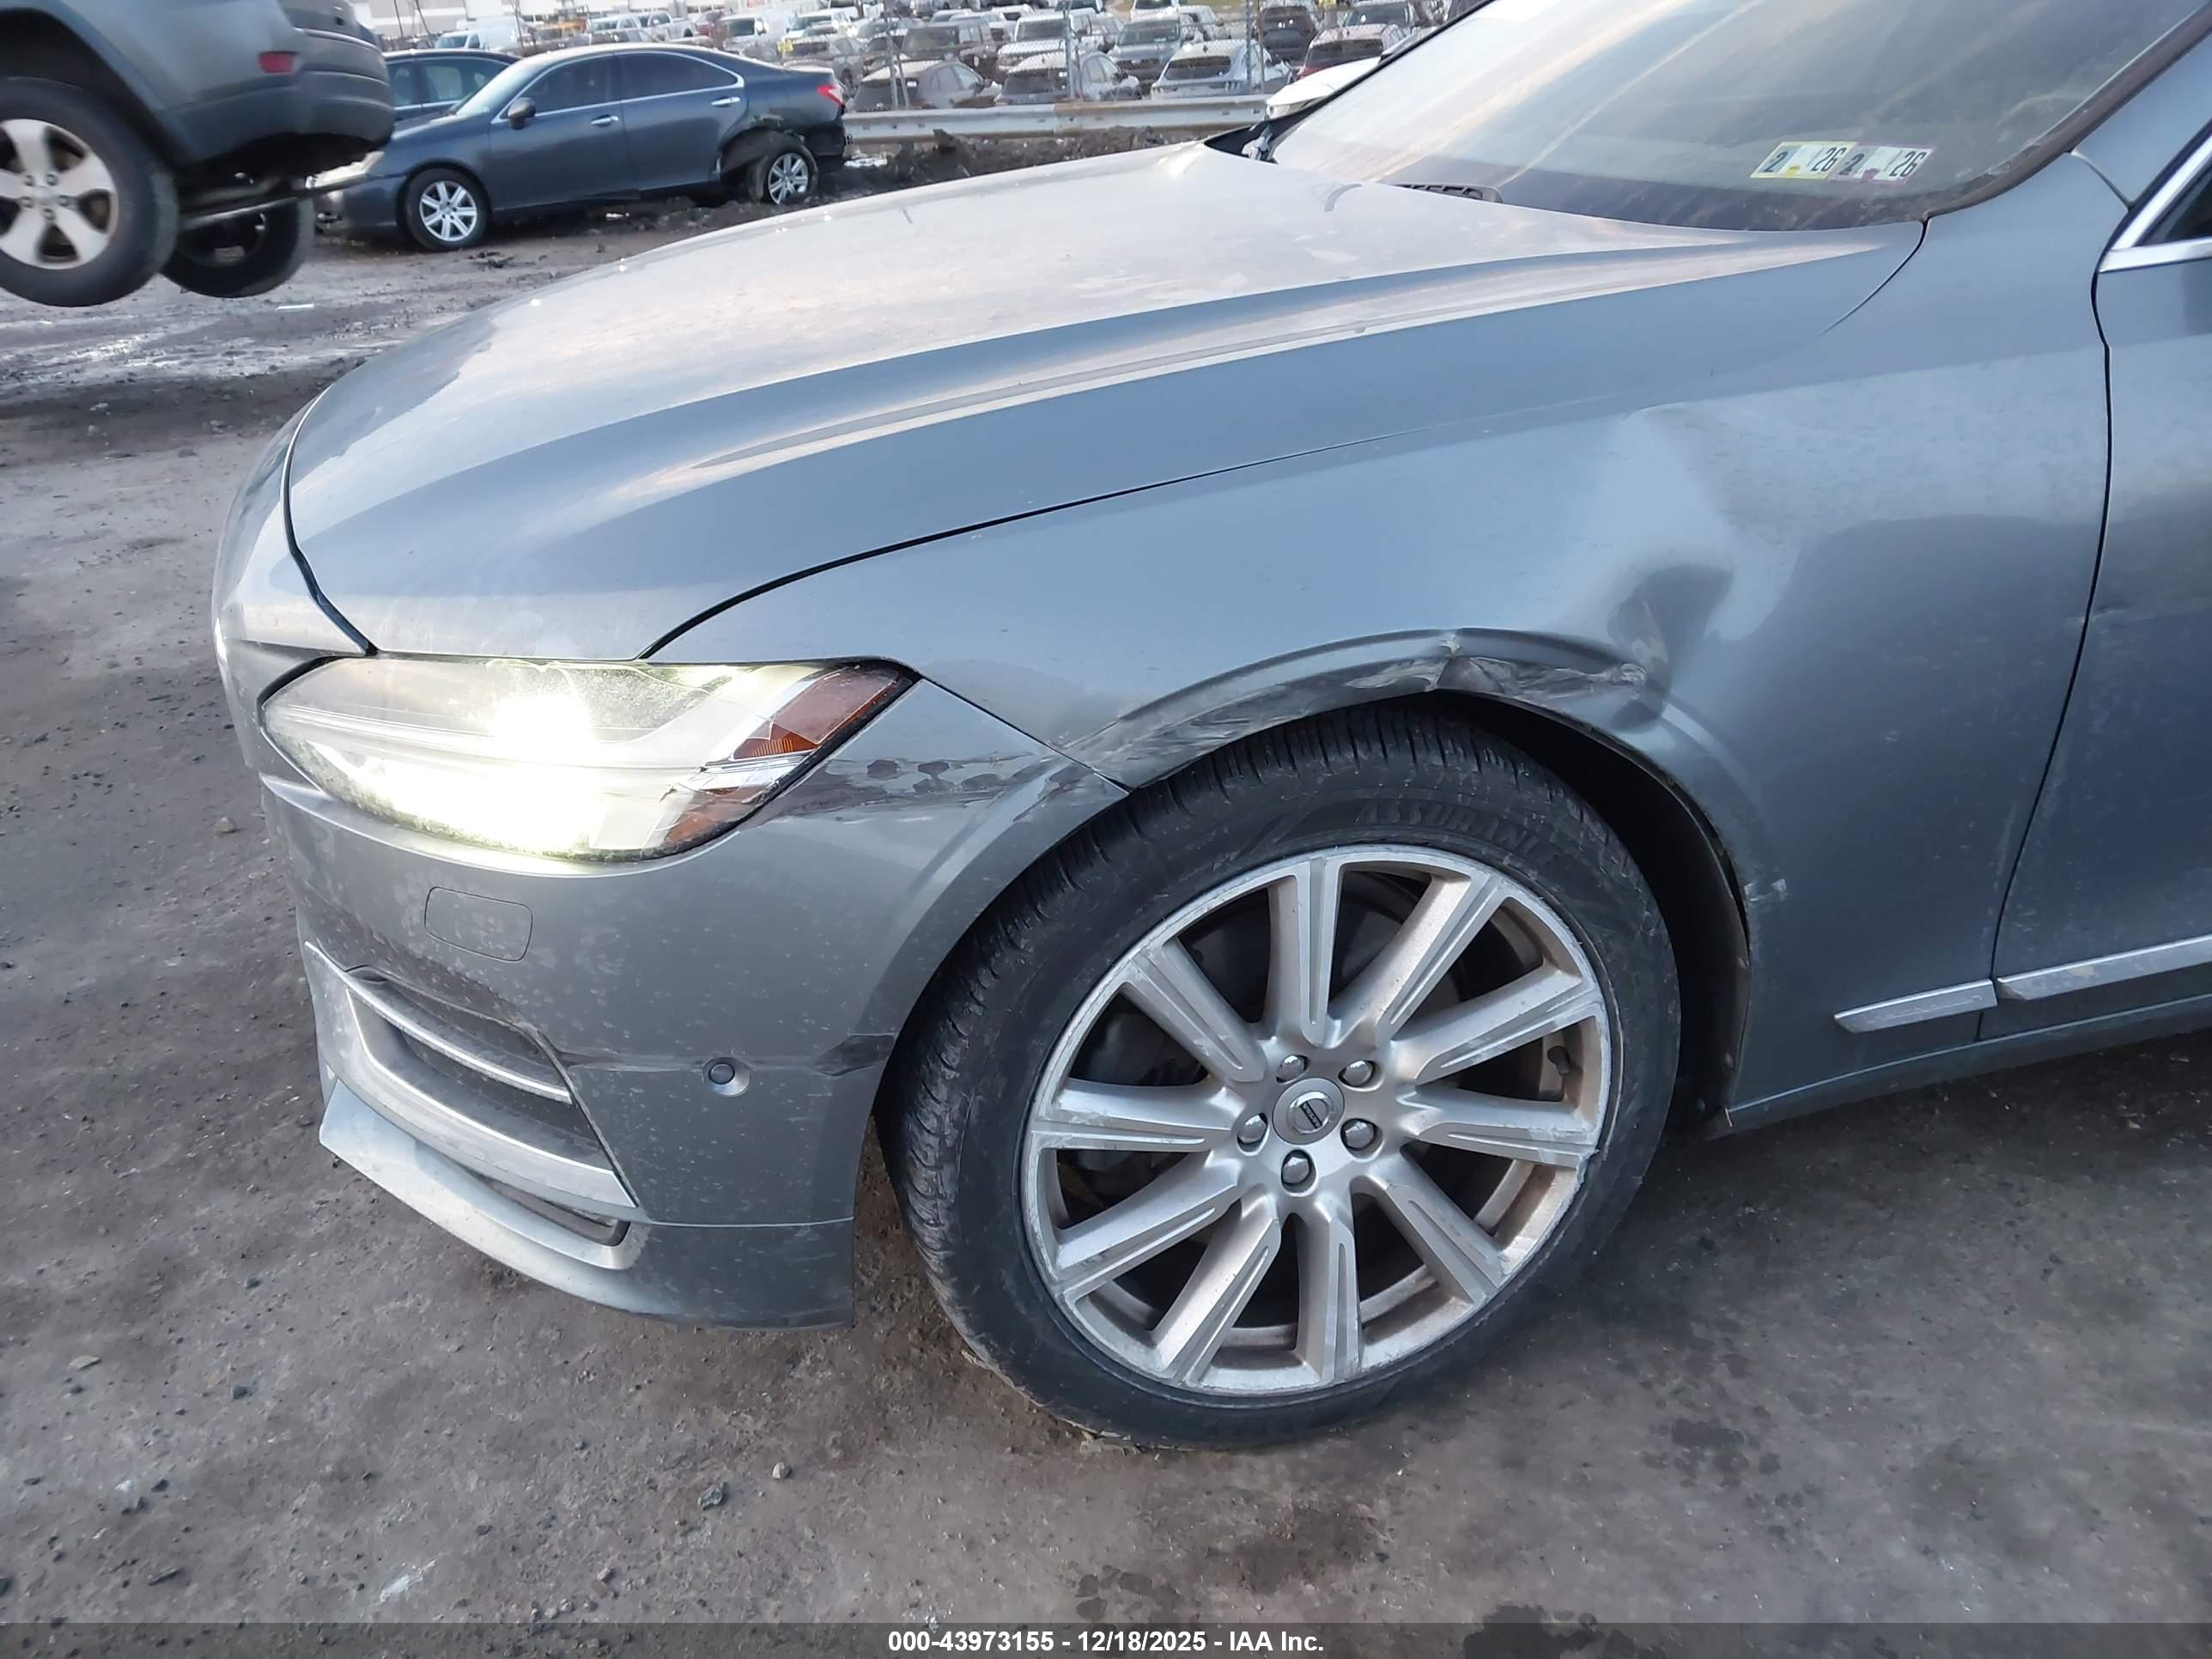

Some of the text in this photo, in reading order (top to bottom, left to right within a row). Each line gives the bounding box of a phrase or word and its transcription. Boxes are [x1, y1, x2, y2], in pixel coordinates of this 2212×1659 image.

[1764, 147, 1848, 173] 2 26
[1838, 150, 1928, 178] 2 26
